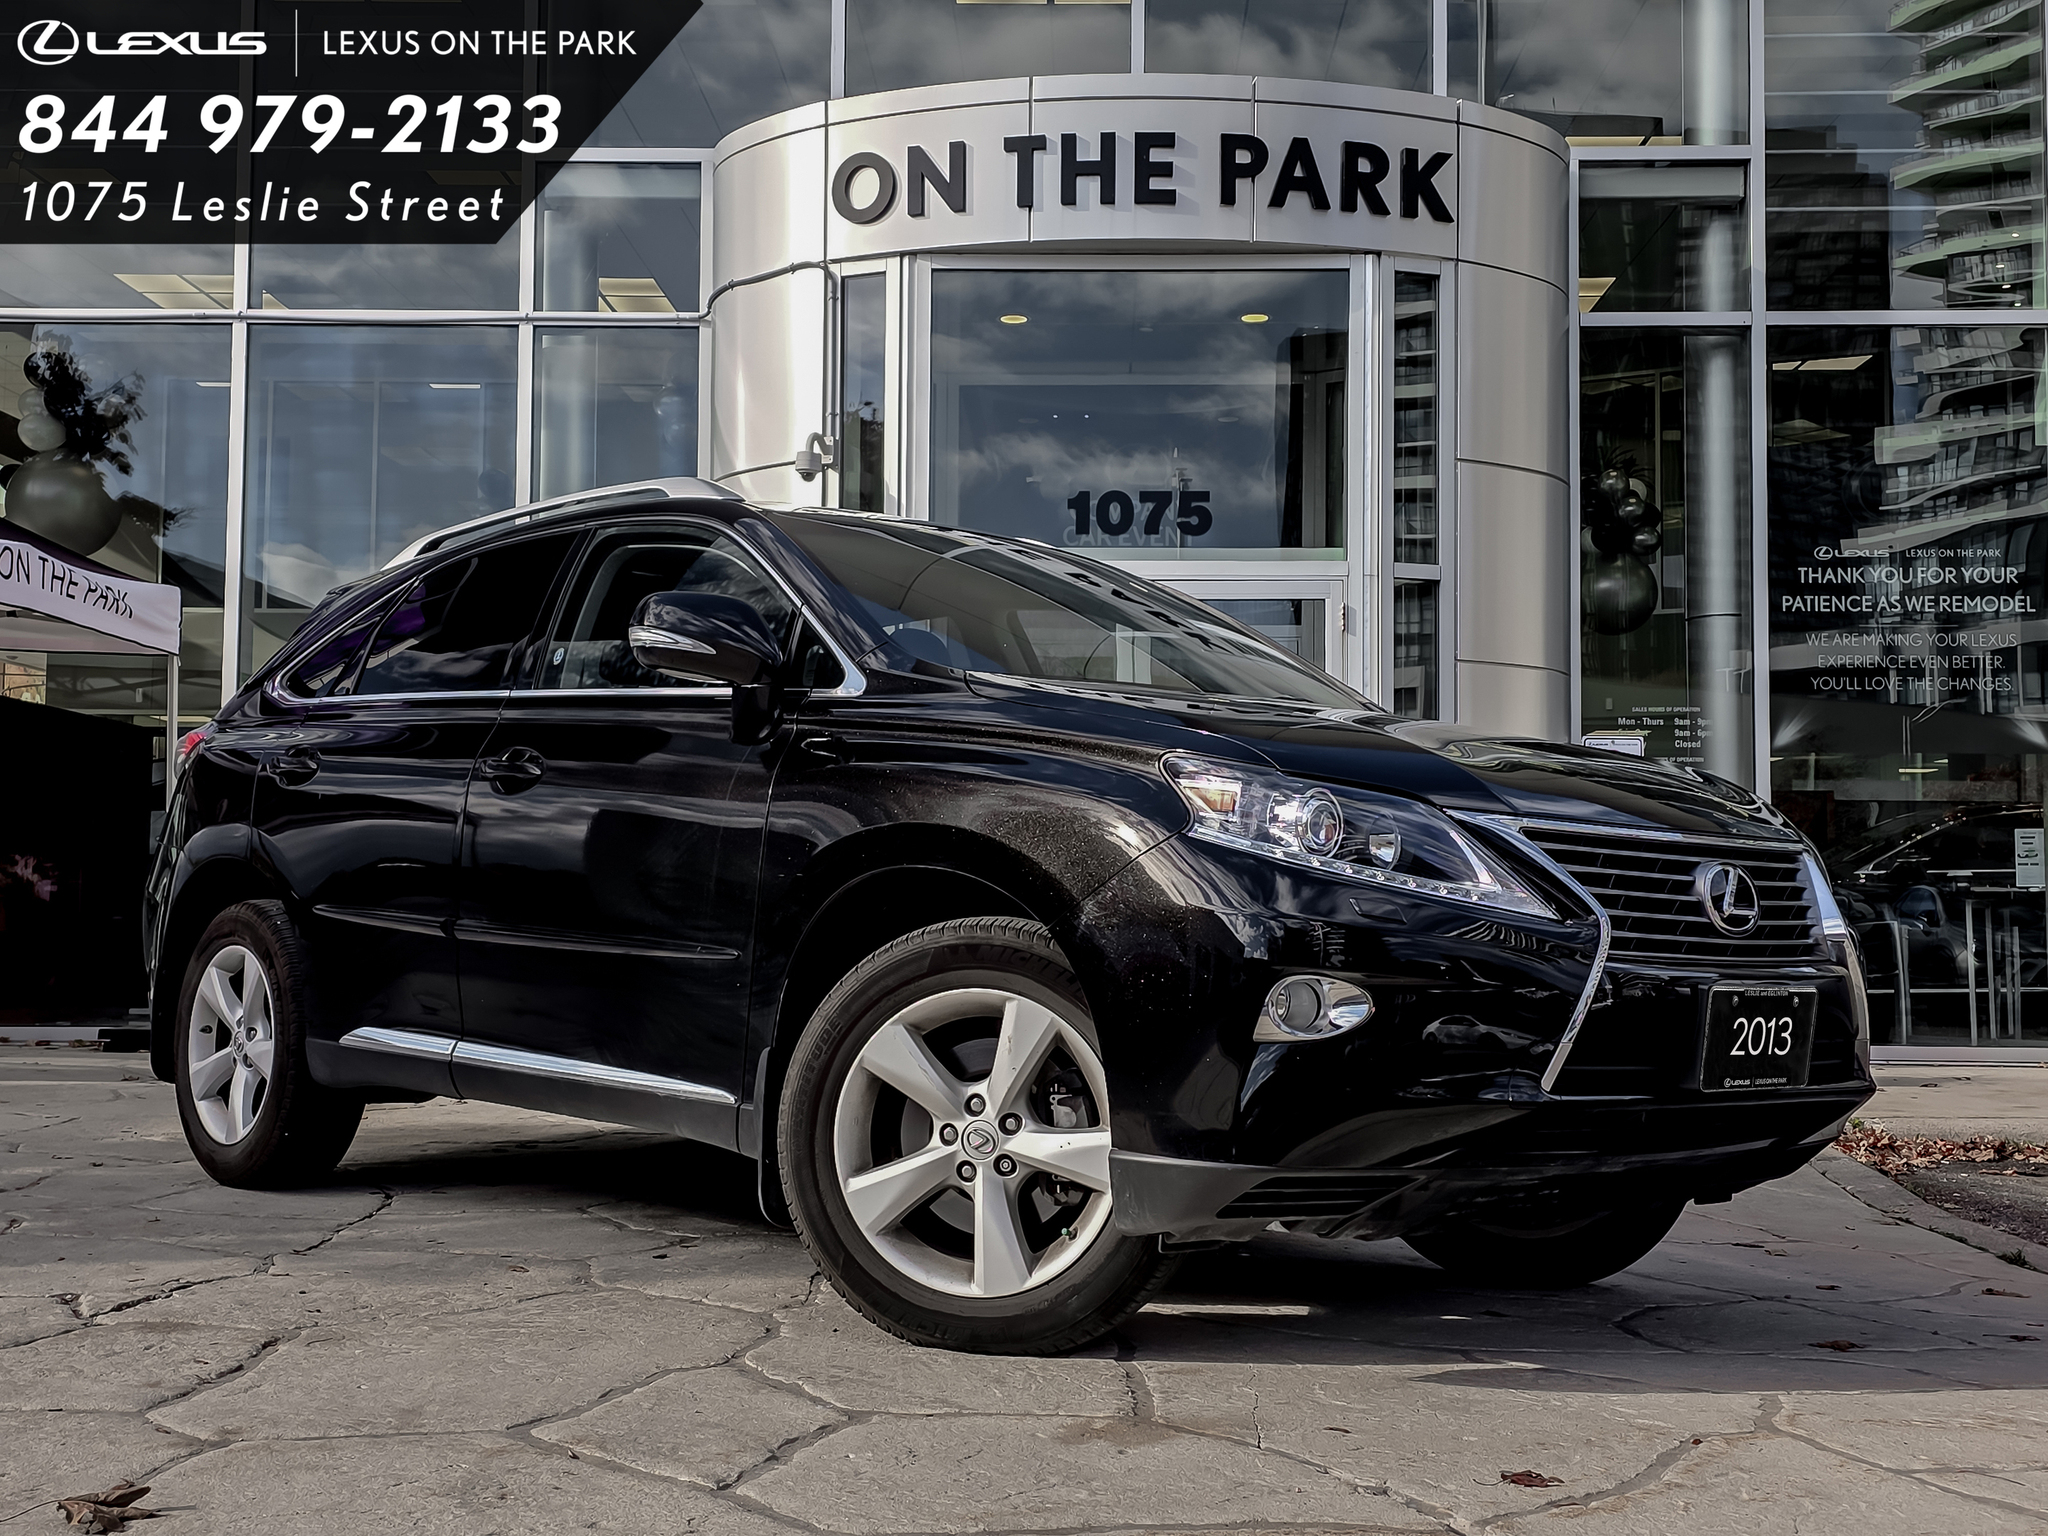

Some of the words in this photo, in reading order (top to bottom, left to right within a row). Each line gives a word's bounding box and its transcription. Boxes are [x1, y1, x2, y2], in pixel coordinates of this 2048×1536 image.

[831, 139, 968, 225] ON
[1003, 131, 1178, 209] THE
[1219, 132, 1455, 224] PARK
[1067, 489, 1213, 536] 1075
[1835, 549, 1890, 558] LEXUS
[1905, 549, 1936, 558] LEXUS
[1938, 549, 1953, 558] ON
[1957, 549, 1974, 558] THE
[1977, 549, 2002, 558] PARK
[0, 545, 32, 586] ON
[38, 555, 79, 600] THE
[83, 574, 134, 619] PARK
[1797, 567, 1865, 584] THANK
[1868, 567, 1913, 584] YOU
[1917, 567, 1958, 584] FOR
[1960, 567, 2019, 584] YOUR
[1782, 595, 1873, 612] PATIENCE
[1876, 595, 1901, 612] AS
[1904, 595, 1936, 612] WE
[1939, 595, 2036, 612] REMODEL
[1805, 633, 1829, 647] WE
[1832, 633, 1860, 647] ARE
[1863, 633, 1923, 647] MAKING
[1926, 633, 1969, 647] YOUR
[1971, 633, 2018, 647] LEXUS
[1818, 655, 1906, 668] EXPERIENCE
[1909, 655, 1949, 668] EVEN
[1952, 655, 2006, 669] BETTER.
[1810, 676, 1862, 690] YOU'LL
[1865, 676, 1903, 691] LOVE
[1907, 676, 1934, 691] THE
[1937, 676, 2014, 691] CHANGES.
[1618, 717, 1636, 726] Mon
[1642, 717, 1665, 726] Thurs
[1674, 718, 1691, 726] 9am
[1674, 729, 1691, 737] 9am
[1674, 740, 1702, 748] Closed
[1729, 1016, 1793, 1056] 2013
